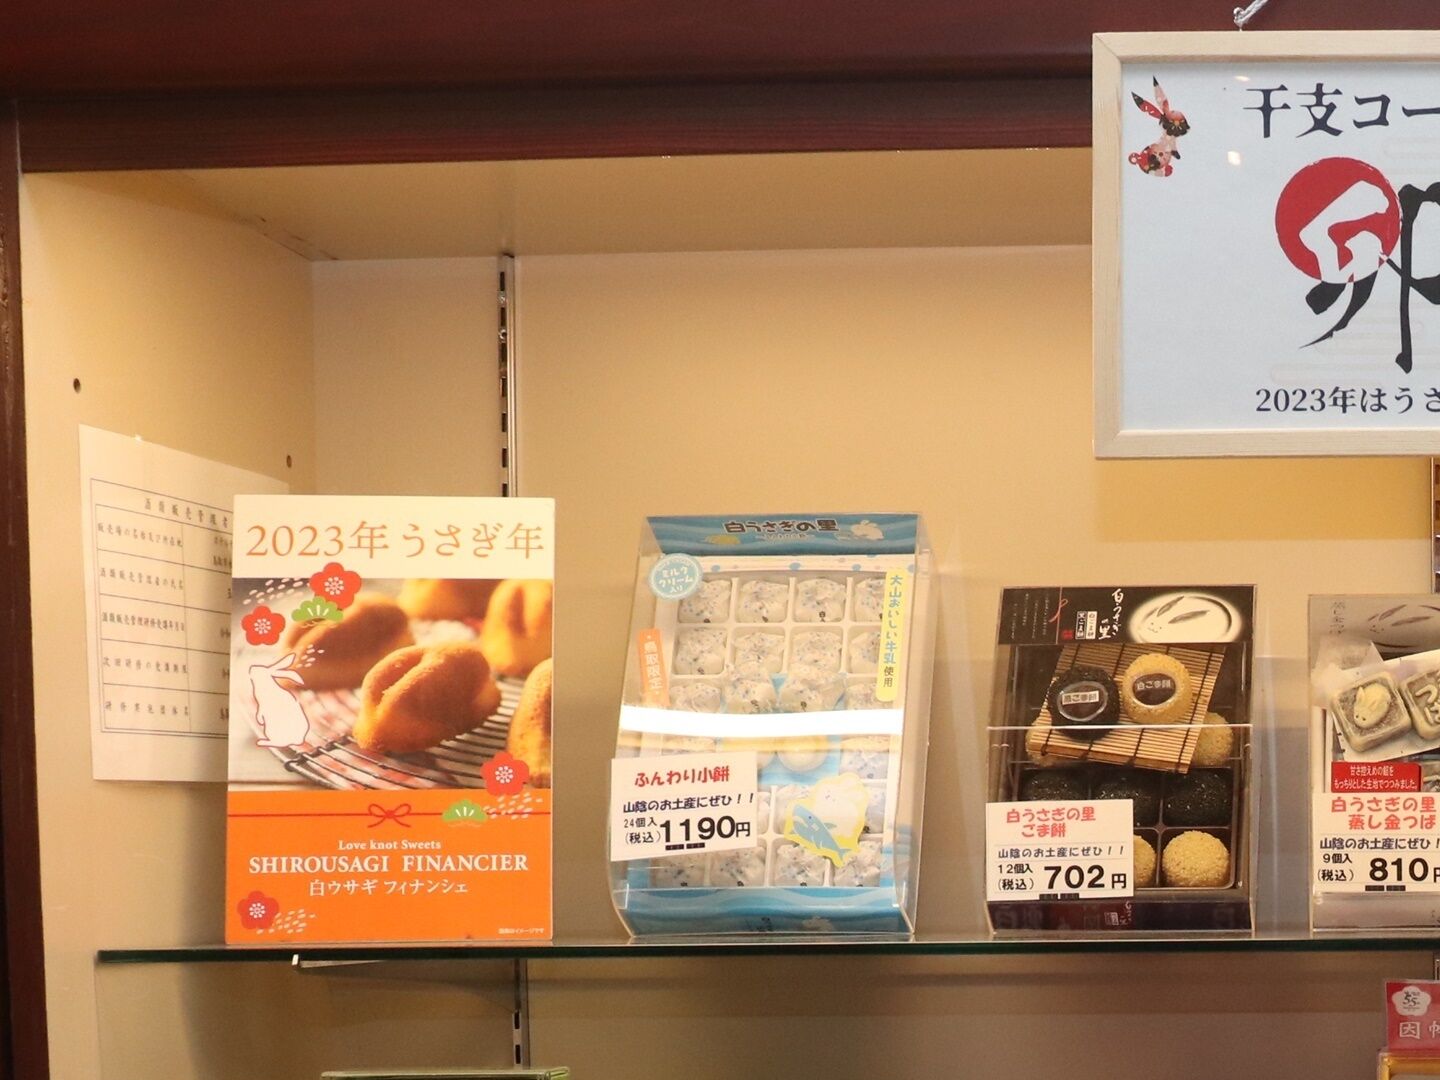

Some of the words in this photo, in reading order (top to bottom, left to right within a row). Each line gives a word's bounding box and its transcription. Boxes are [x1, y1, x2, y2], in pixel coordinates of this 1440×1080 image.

[724, 519, 839, 533] 白うさぎの里
[662, 567, 688, 578] ミルク
[659, 576, 693, 585] クリーム
[635, 767, 730, 788] ふんわり小餅
[1331, 797, 1436, 813] 白うさぎの里
[1007, 807, 1096, 822] 白うさぎの里
[1348, 814, 1436, 830] 蒸し金つば
[1021, 822, 1066, 838] ごま餅
[339, 840, 365, 850] Love
[370, 840, 398, 850] knot
[401, 840, 441, 850] Sweets
[249, 856, 389, 874] SHIROUSAGI
[402, 854, 528, 872] FINANCIER
